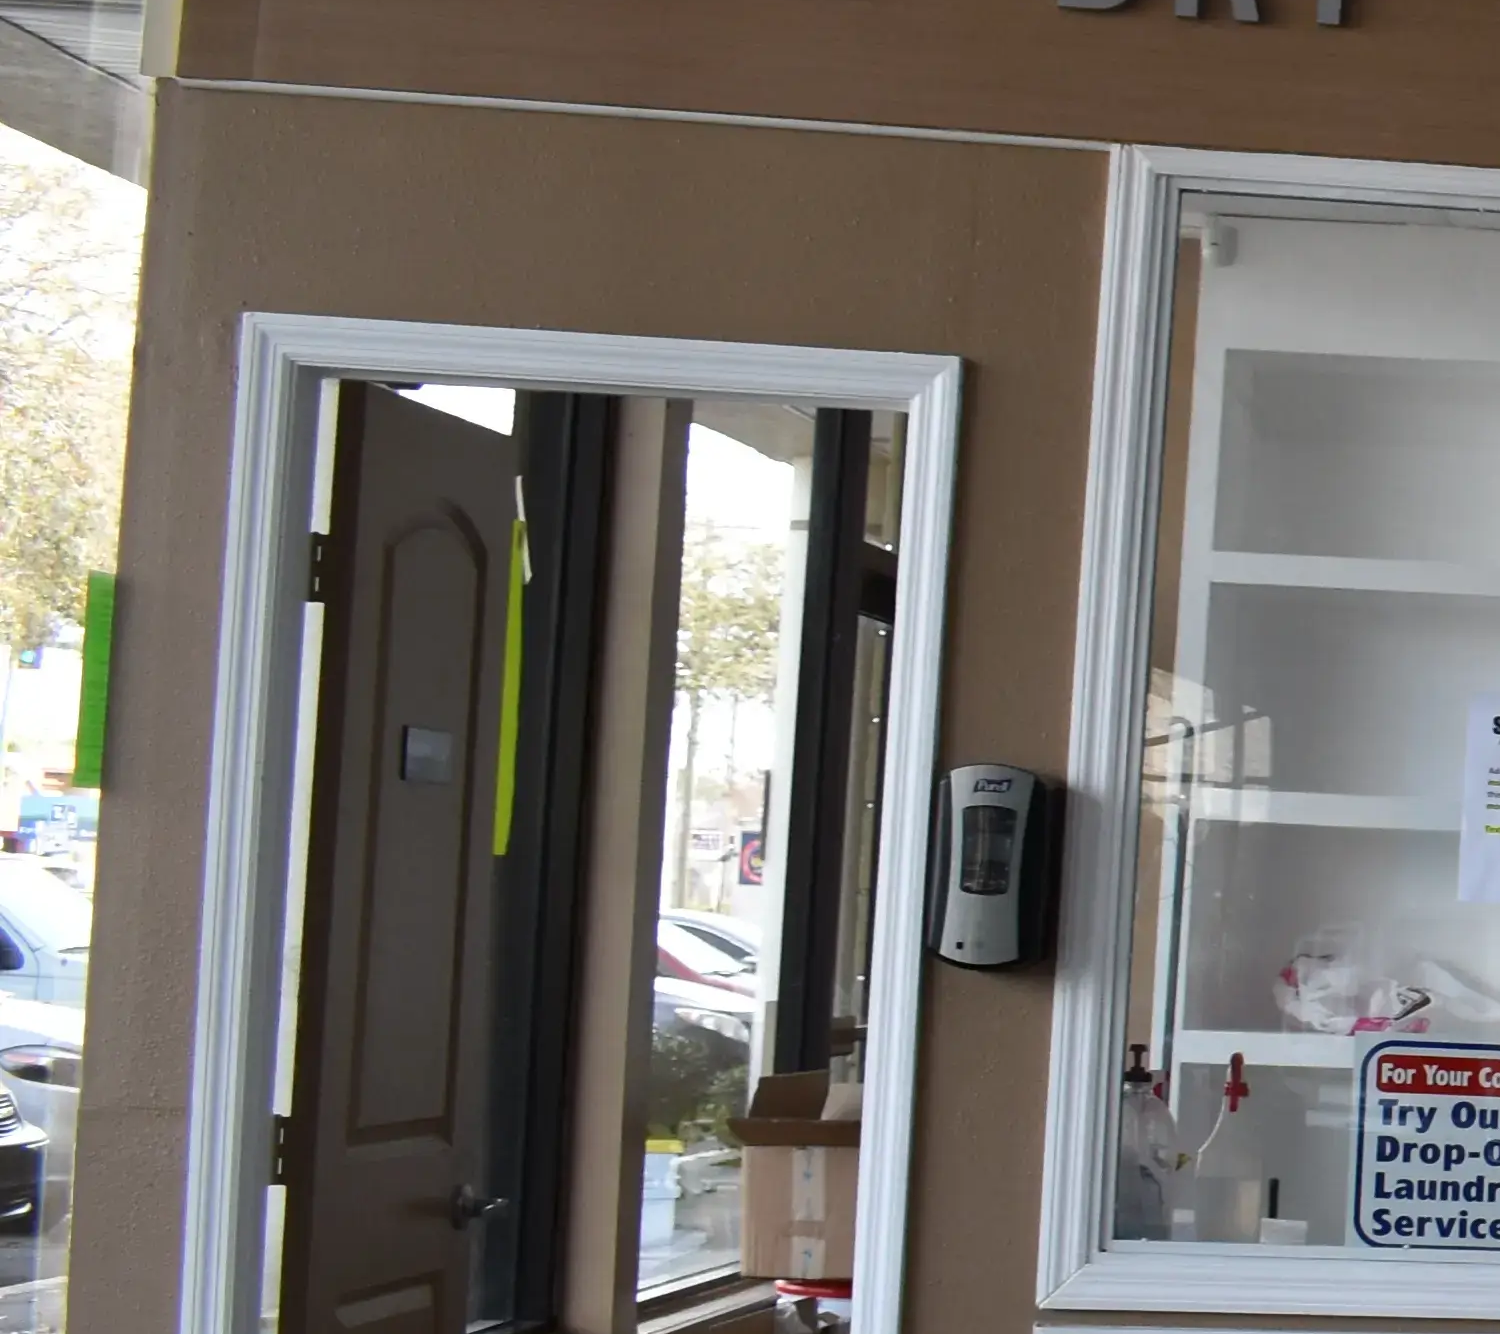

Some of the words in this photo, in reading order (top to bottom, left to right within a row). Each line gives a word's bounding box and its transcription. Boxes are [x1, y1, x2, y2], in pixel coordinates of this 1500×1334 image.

[1381, 1063, 1416, 1084] For
[1419, 1064, 1472, 1087] Your
[1378, 1099, 1437, 1133] Try
